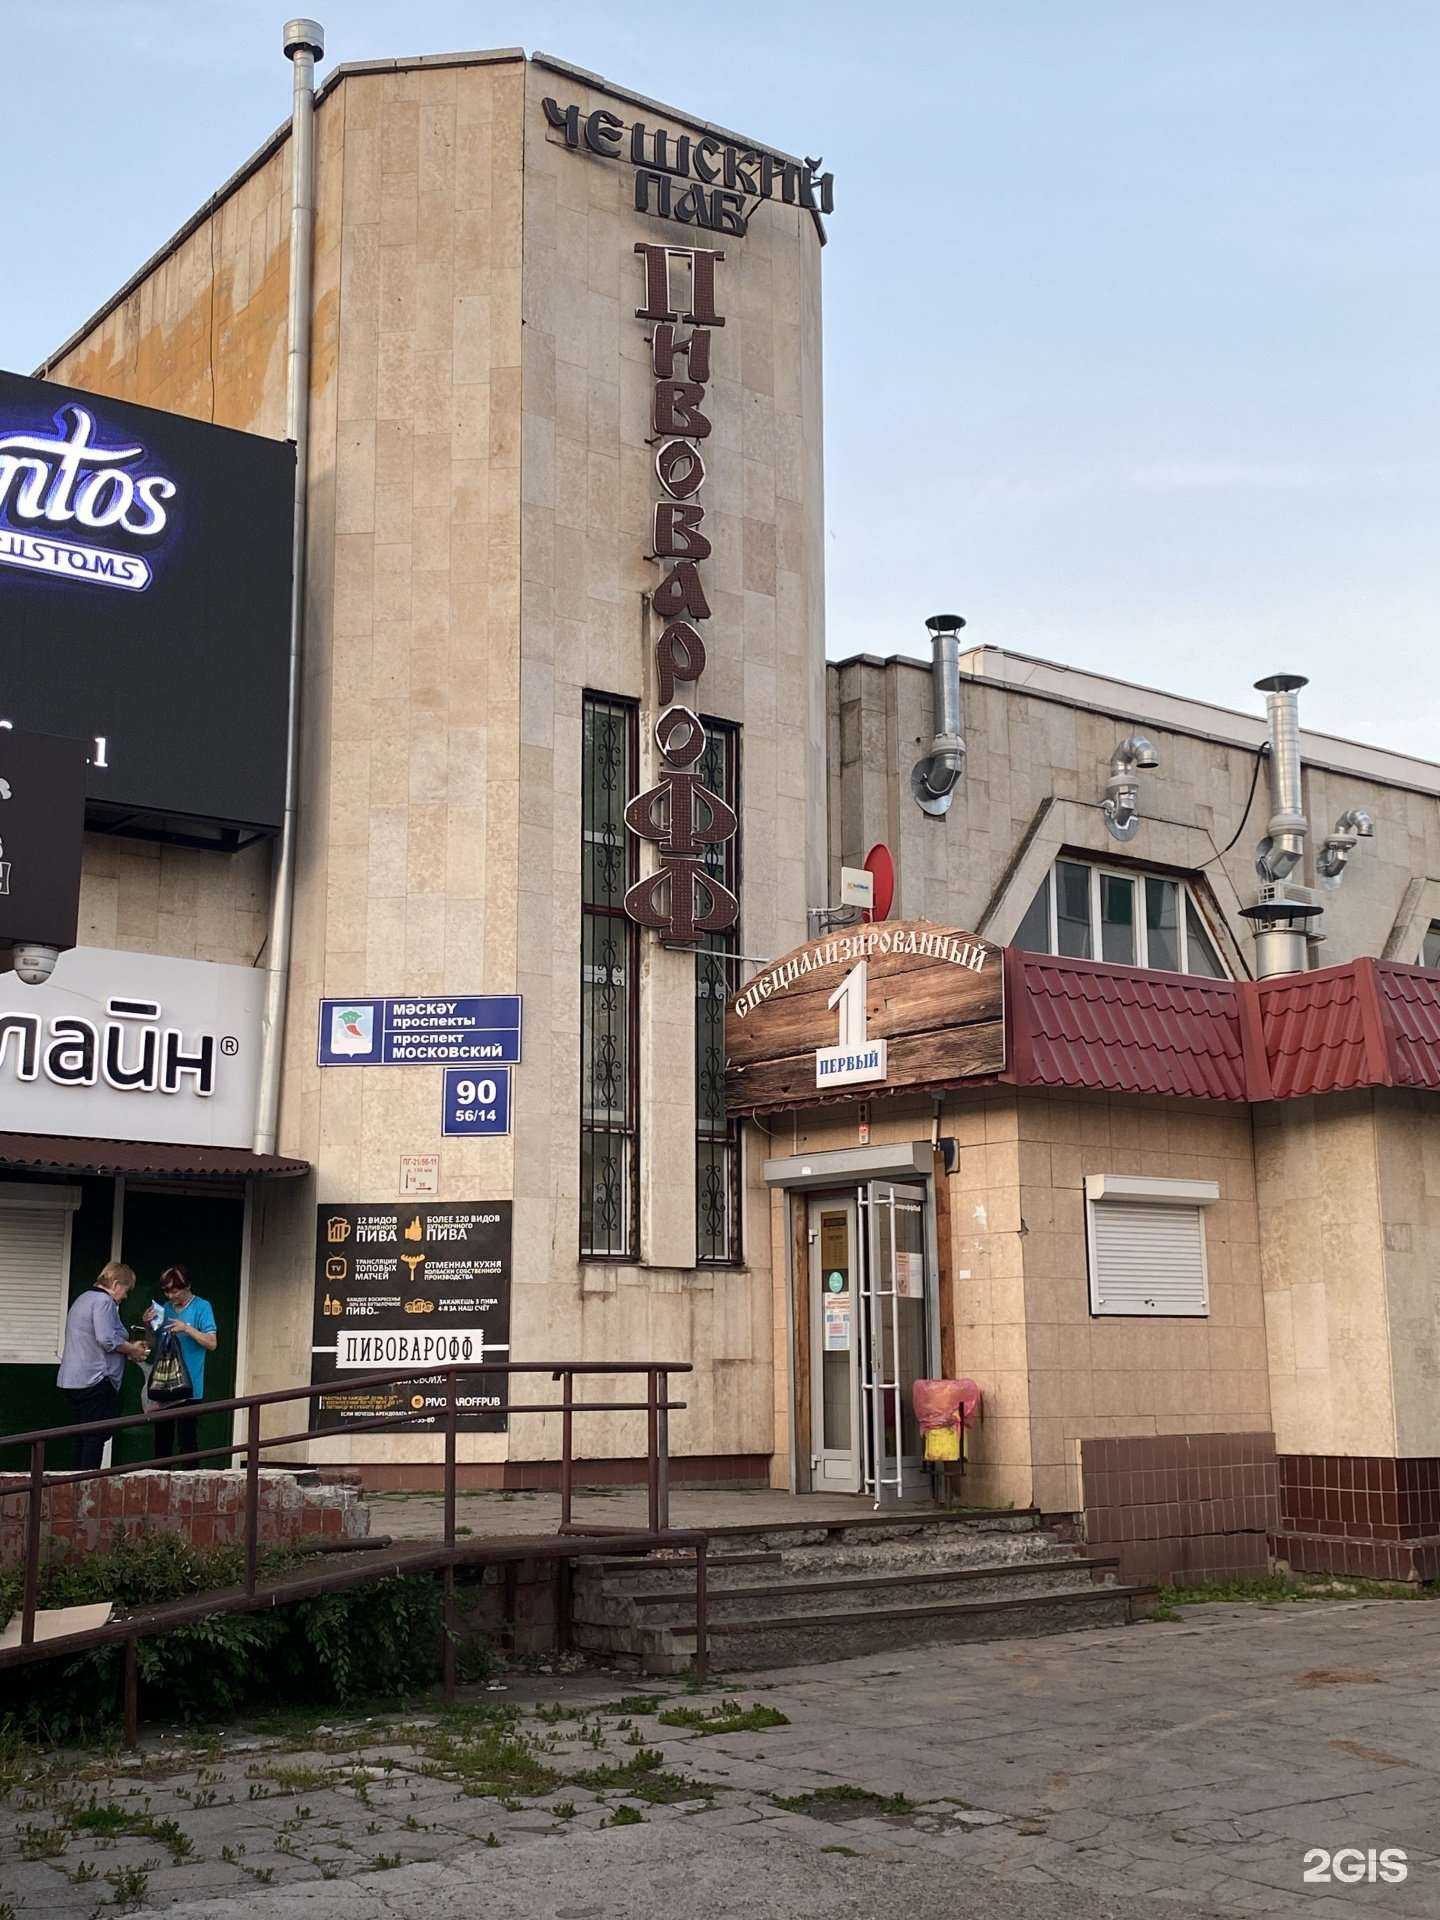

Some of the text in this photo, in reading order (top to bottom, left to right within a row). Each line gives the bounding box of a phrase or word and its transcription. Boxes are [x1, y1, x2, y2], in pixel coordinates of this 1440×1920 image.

[542, 97, 834, 214] ЧЕШСКИЙ
[634, 168, 749, 238] ПАБ
[0, 535, 139, 581] USTOMS
[734, 930, 988, 1018] СПЕЦИАЛИЗИРОВАННЫЙ
[393, 1016, 476, 1029] проспекты
[393, 1034, 464, 1046] проспект
[392, 1043, 503, 1059] МОСКОВСКИЙ
[819, 1051, 879, 1076] ПЕРВЫЙ
[456, 1080, 497, 1105] 90
[455, 1110, 497, 1122] 56/14
[368, 1216, 398, 1225] ВИДОВ
[426, 1214, 500, 1224] БОЛЕЕ 120 ВИДОВ
[356, 1230, 398, 1242] ПИВА
[426, 1228, 468, 1241] ПИВА
[331, 1264, 341, 1272] TV
[355, 1264, 397, 1272] ТОПОВЫХ
[424, 1260, 502, 1269] ОТМЕННАЯ КУХНЯ
[354, 1271, 390, 1280] МАТЧЕЙ
[346, 1336, 473, 1362] ПИВОВАРОФФ
